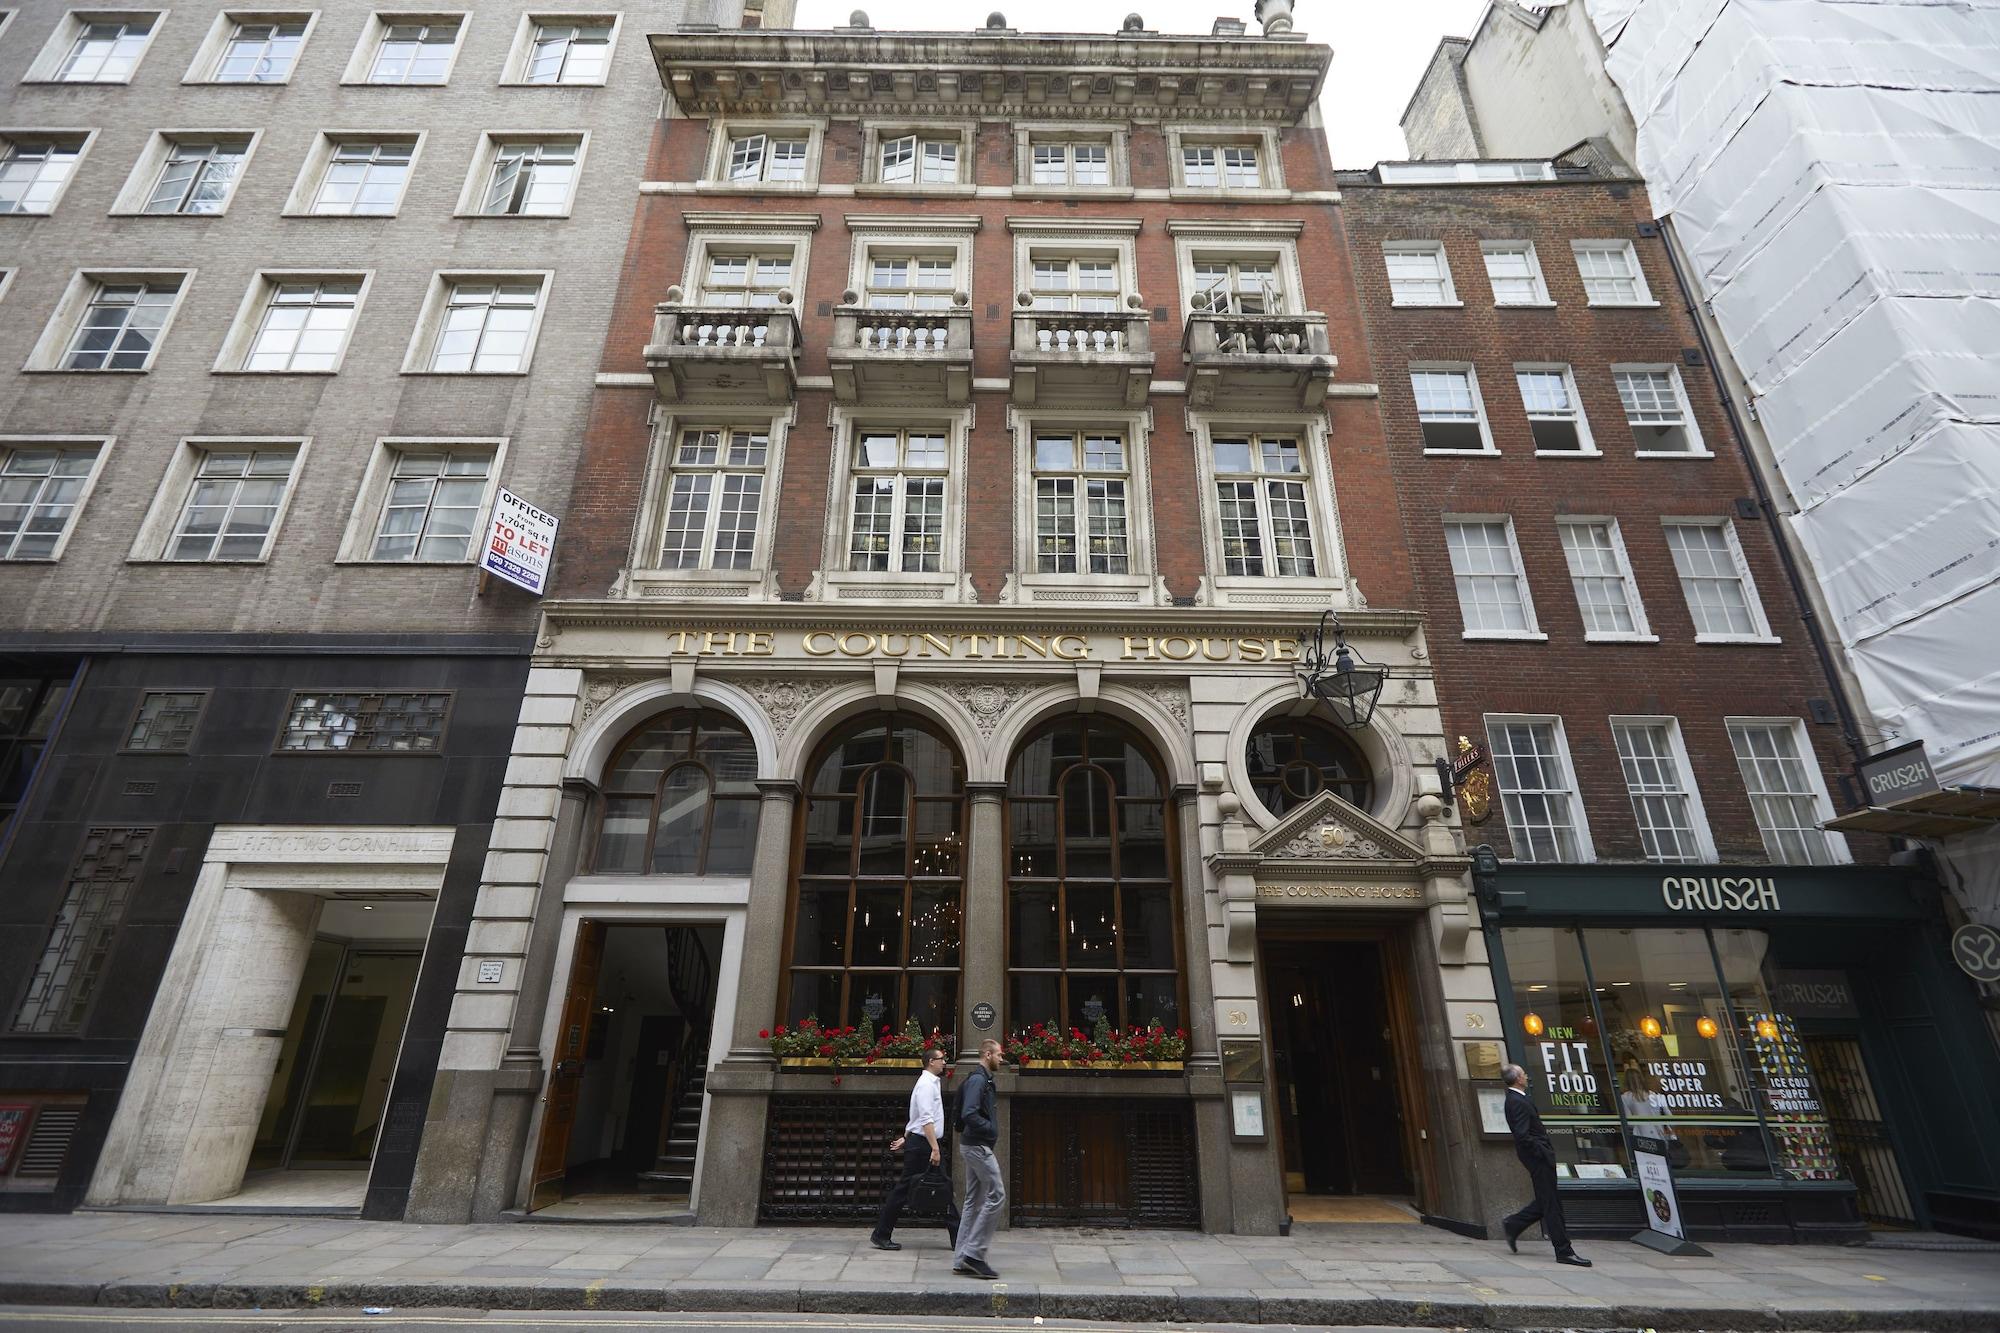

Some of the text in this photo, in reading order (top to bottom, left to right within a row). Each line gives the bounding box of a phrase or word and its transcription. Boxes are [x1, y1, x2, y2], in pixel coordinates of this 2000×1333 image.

[503, 494, 555, 528] OFFICES
[500, 512, 549, 544] 1,704 sq ft
[517, 514, 535, 528] From
[495, 522, 549, 556] TO LET
[490, 554, 503, 566] 020
[492, 537, 544, 570] masons
[666, 631, 1301, 662] THE COUNTING HOUSE
[1320, 826, 1344, 846] 50
[1256, 885, 1422, 899] THE COUNTING HOUSE
[1663, 876, 1780, 910] CRUSSH
[1229, 1010, 1248, 1026] 50
[1466, 1013, 1485, 1029] 50
[1548, 1027, 1573, 1039] NEW
[1540, 1042, 1588, 1073] FIT
[1648, 1062, 1706, 1076] ICE COLD
[1546, 1074, 1597, 1093] FOOD
[1660, 1078, 1703, 1092] SUPER
[1770, 1077, 1810, 1088] ICE COLD
[1551, 1094, 1600, 1107] INSTORE
[1648, 1094, 1723, 1108] SMOOTHIES
[1780, 1089, 1809, 1100] SUPER
[1771, 1100, 1820, 1111] SMOOTHIES
